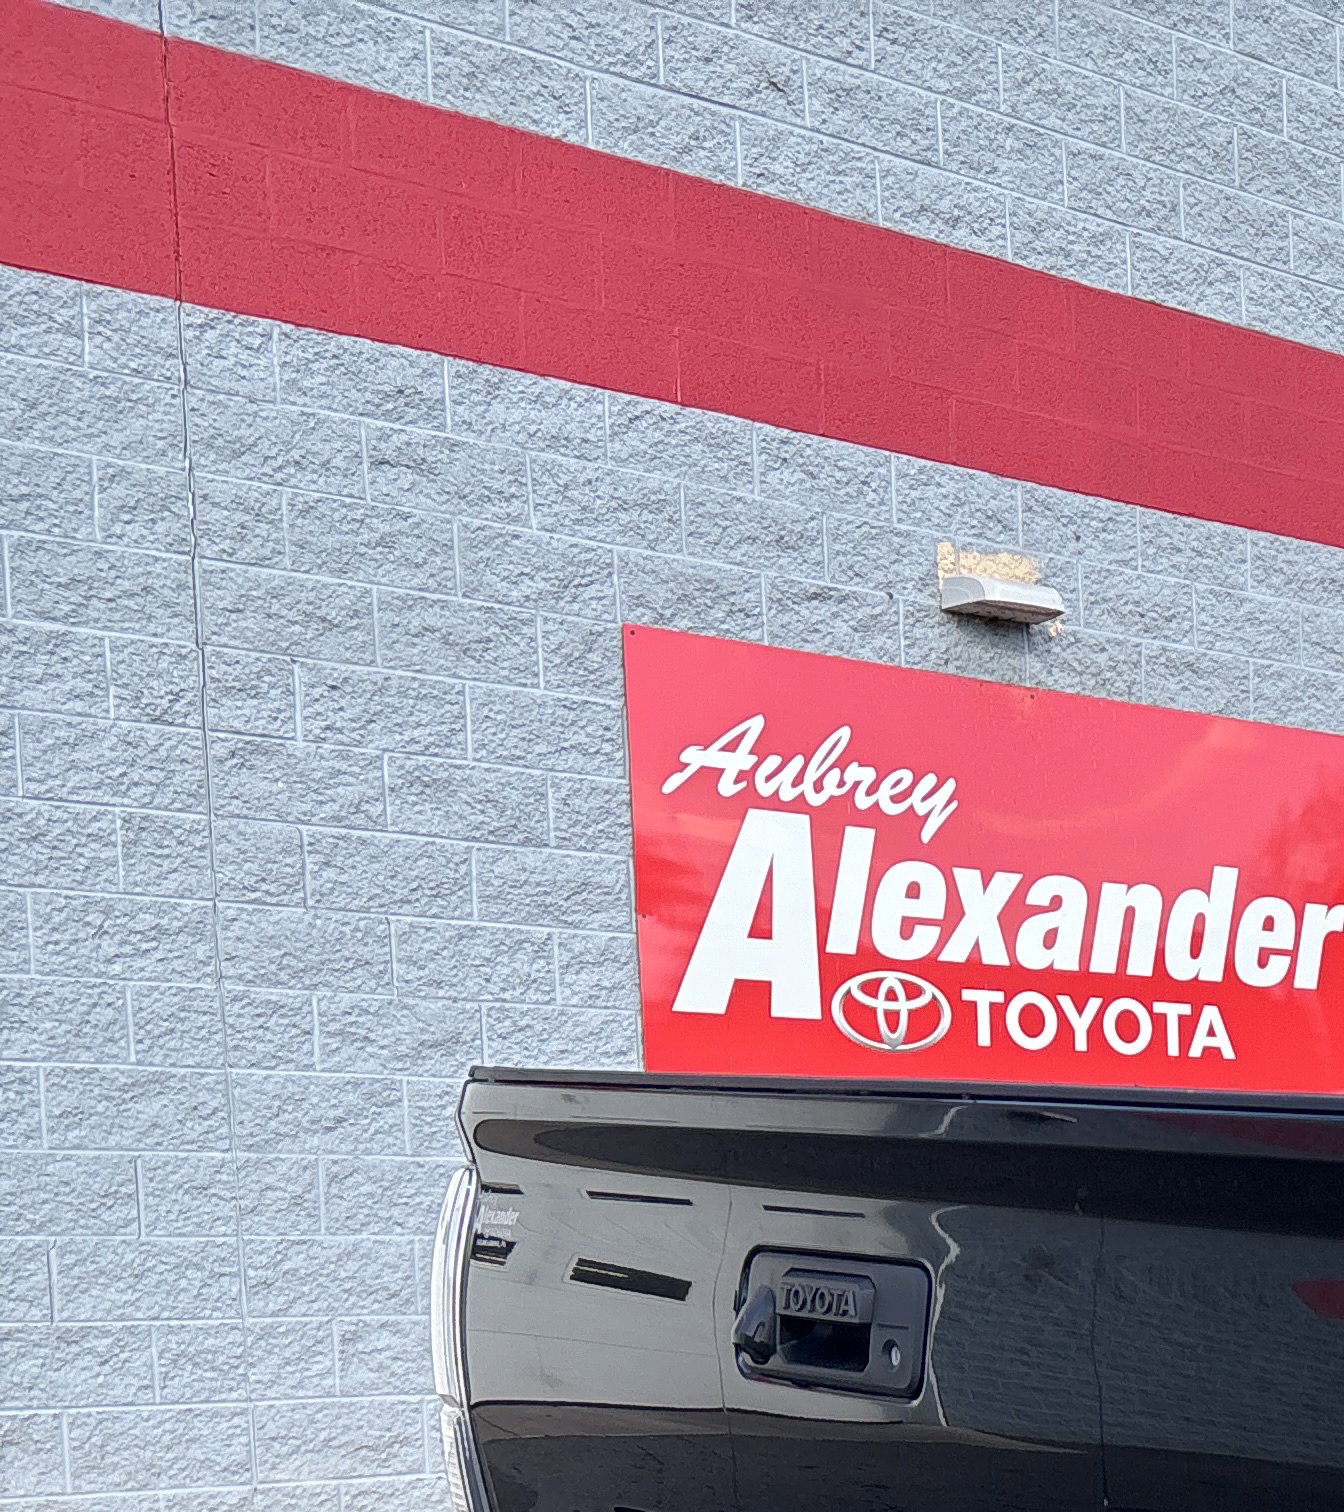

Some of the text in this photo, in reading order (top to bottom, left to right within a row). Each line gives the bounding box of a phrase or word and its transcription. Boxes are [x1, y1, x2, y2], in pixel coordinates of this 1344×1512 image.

[661, 713, 959, 844] Aubrey
[961, 989, 1237, 1061] TOYOTA
[781, 1281, 858, 1318] TOYOTA
